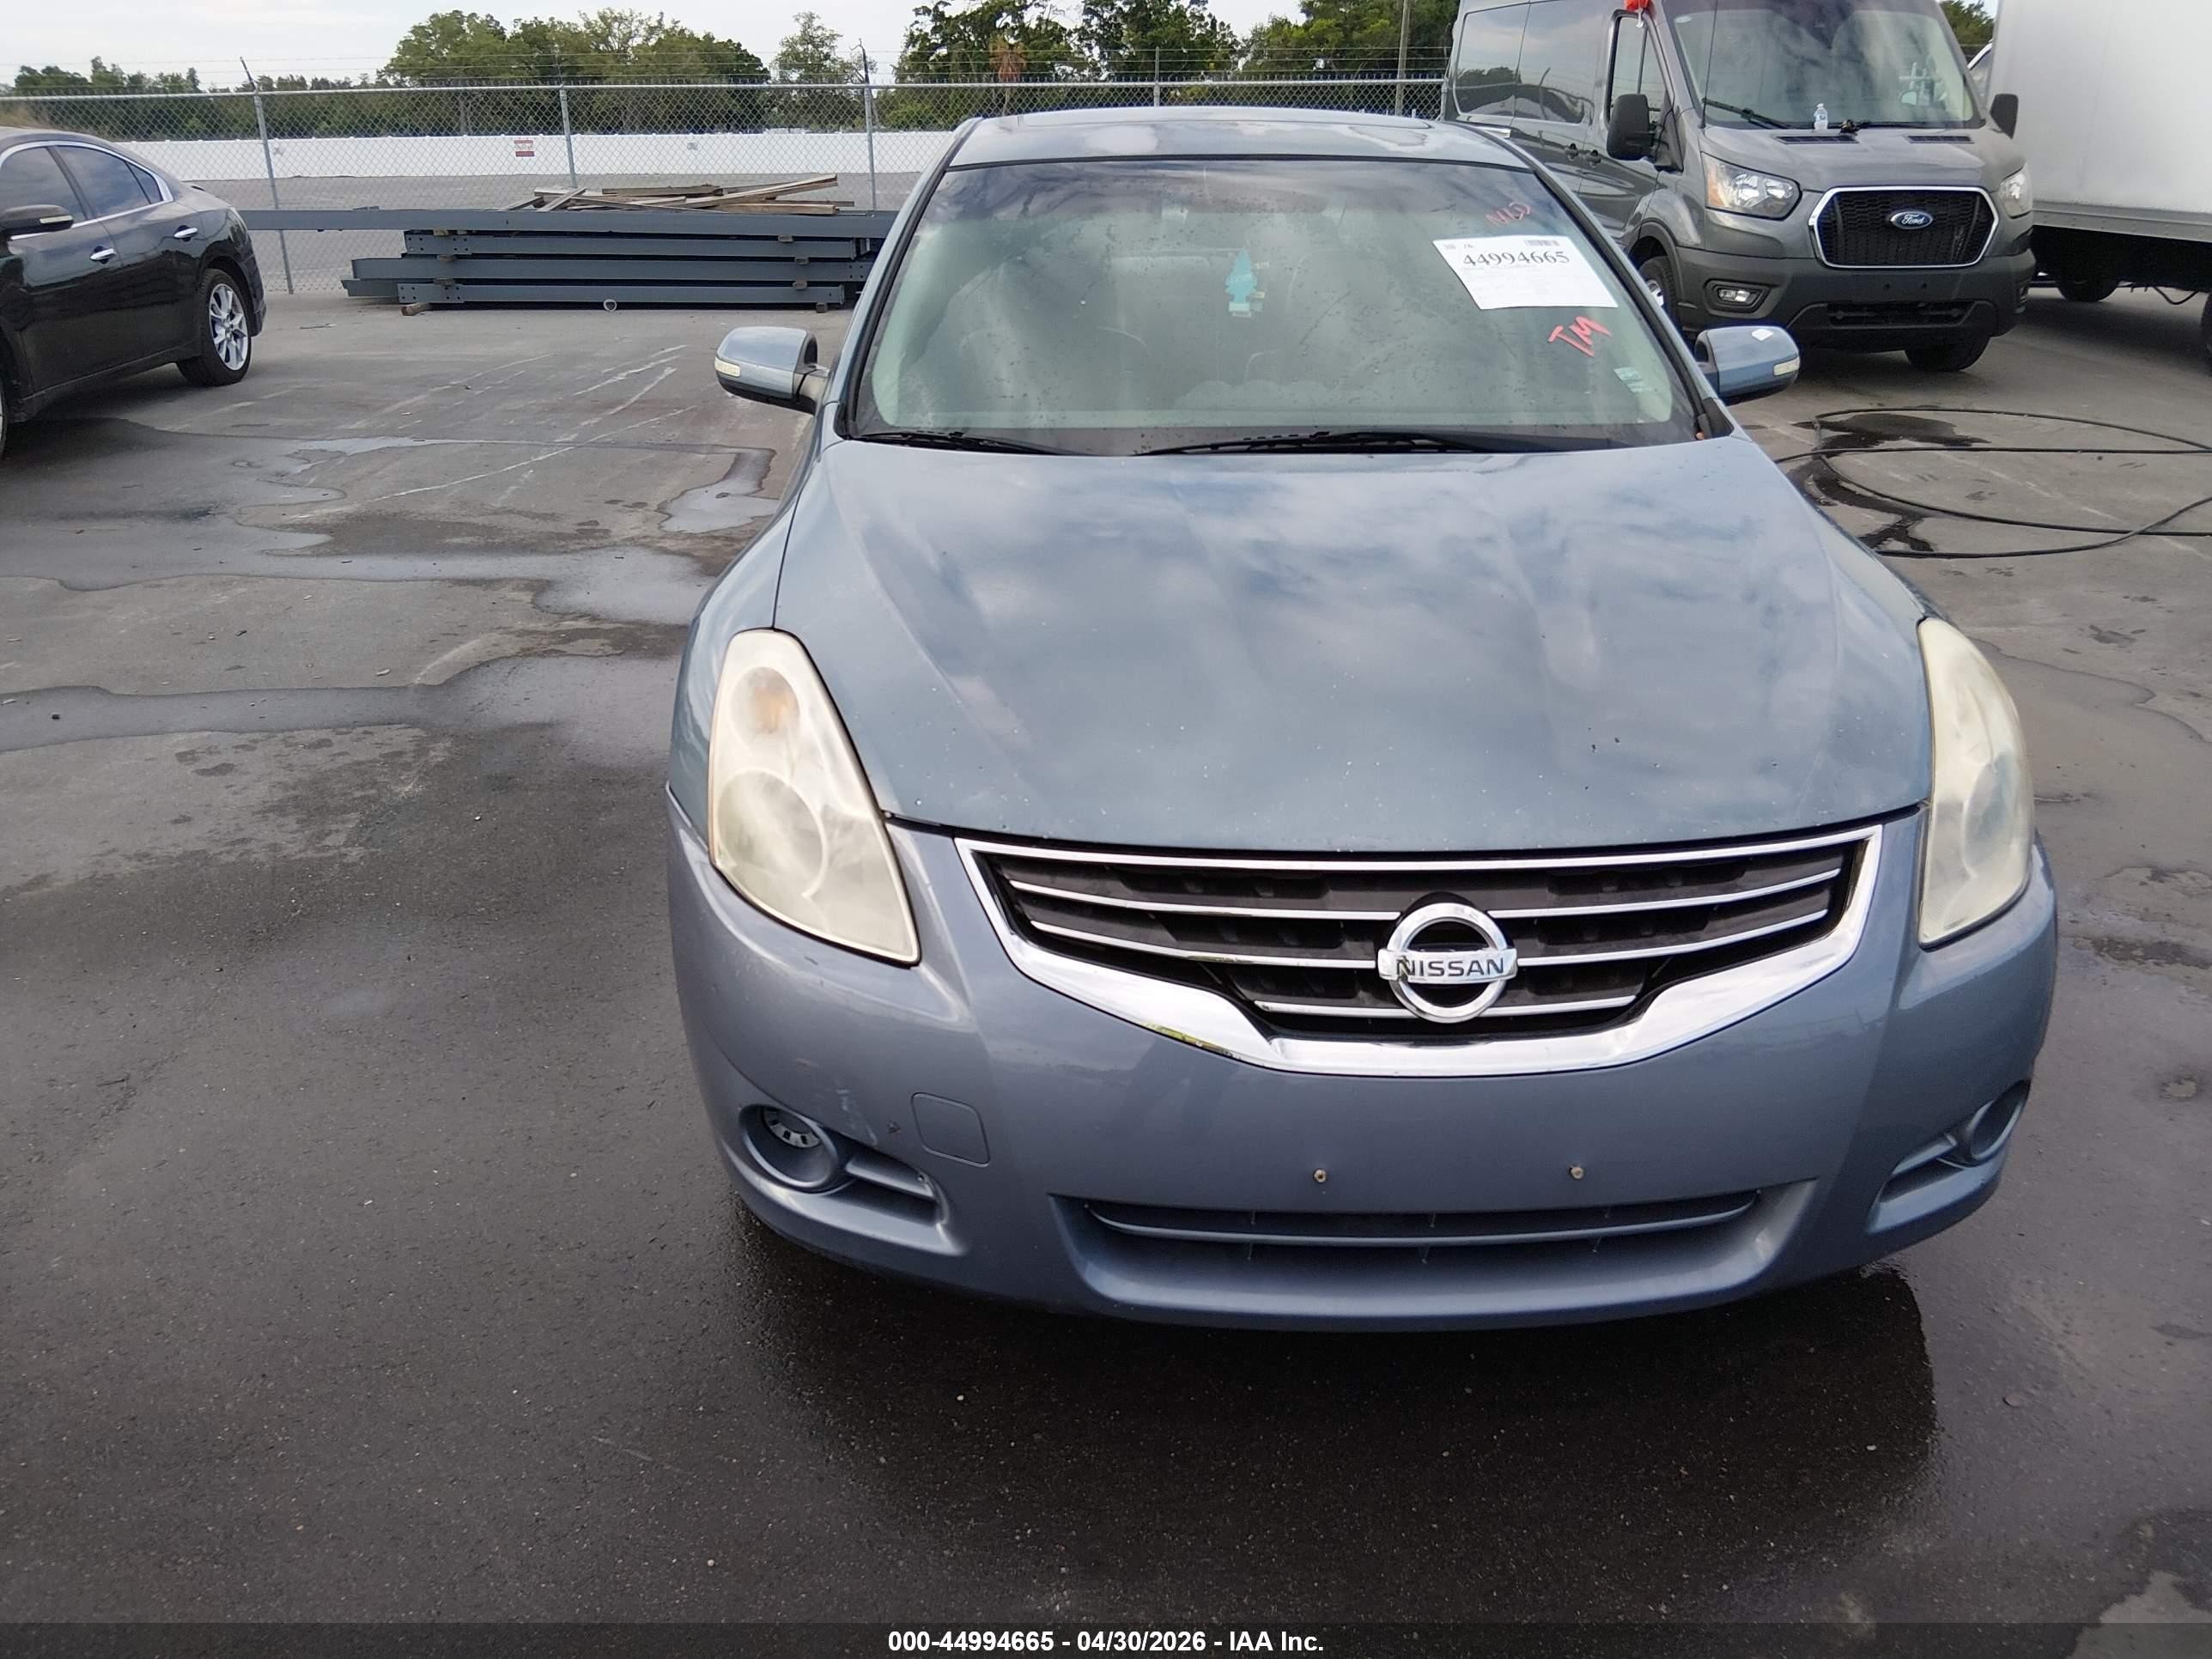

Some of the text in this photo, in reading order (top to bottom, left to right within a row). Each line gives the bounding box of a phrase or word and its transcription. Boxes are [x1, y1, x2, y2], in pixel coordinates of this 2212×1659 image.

[1901, 214, 1925, 225] Ford
[1462, 251, 1570, 266] 44994665
[1548, 315, 1612, 356] TM
[1396, 957, 1504, 977] NISSAN
